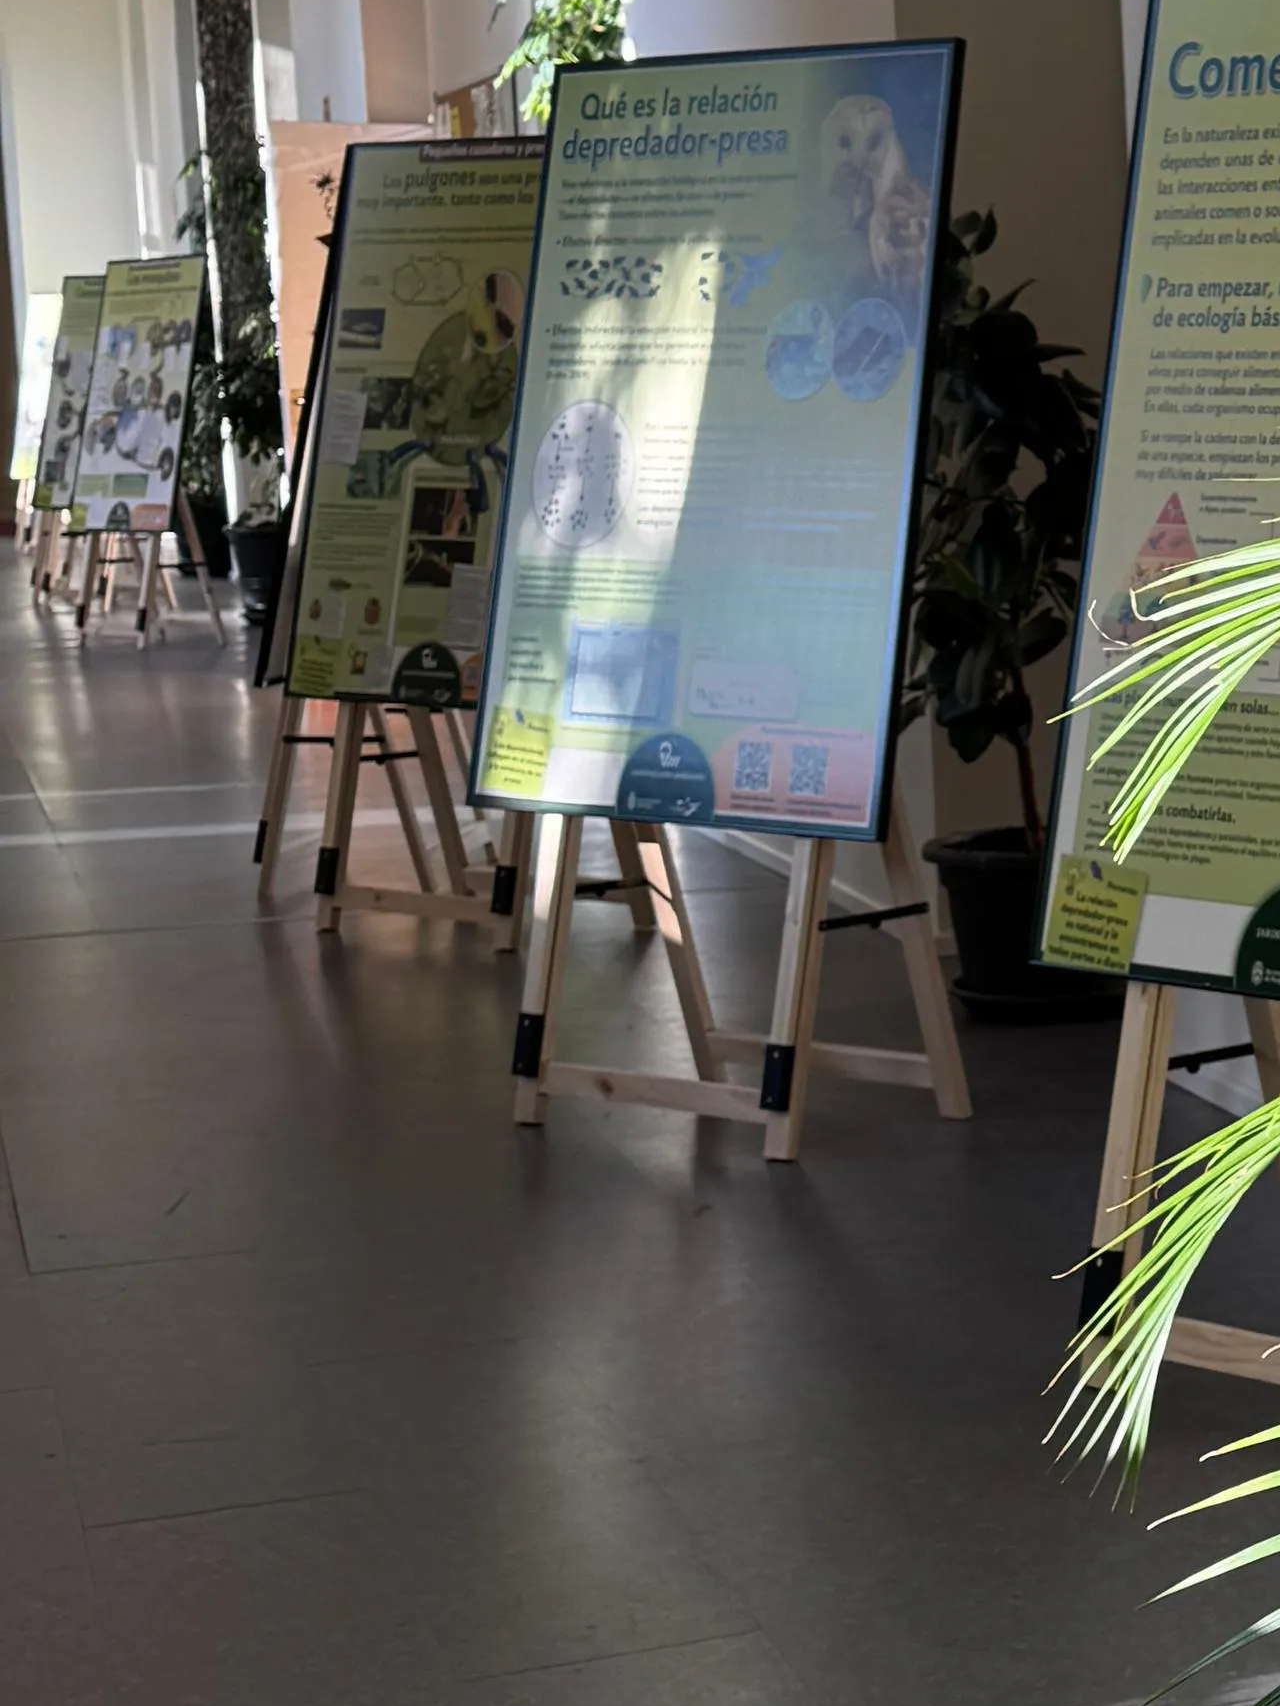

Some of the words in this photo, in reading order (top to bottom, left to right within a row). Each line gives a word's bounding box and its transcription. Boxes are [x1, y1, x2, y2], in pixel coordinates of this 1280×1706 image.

[580, 87, 628, 122] Qué
[632, 98, 657, 119] es
[661, 86, 682, 117] la
[687, 84, 777, 116] relación
[562, 123, 789, 170] depredador-presa
[1156, 277, 1194, 298] Para
[1197, 281, 1274, 304] empezar,
[1152, 305, 1174, 328] de
[1177, 305, 1247, 334] ecología
